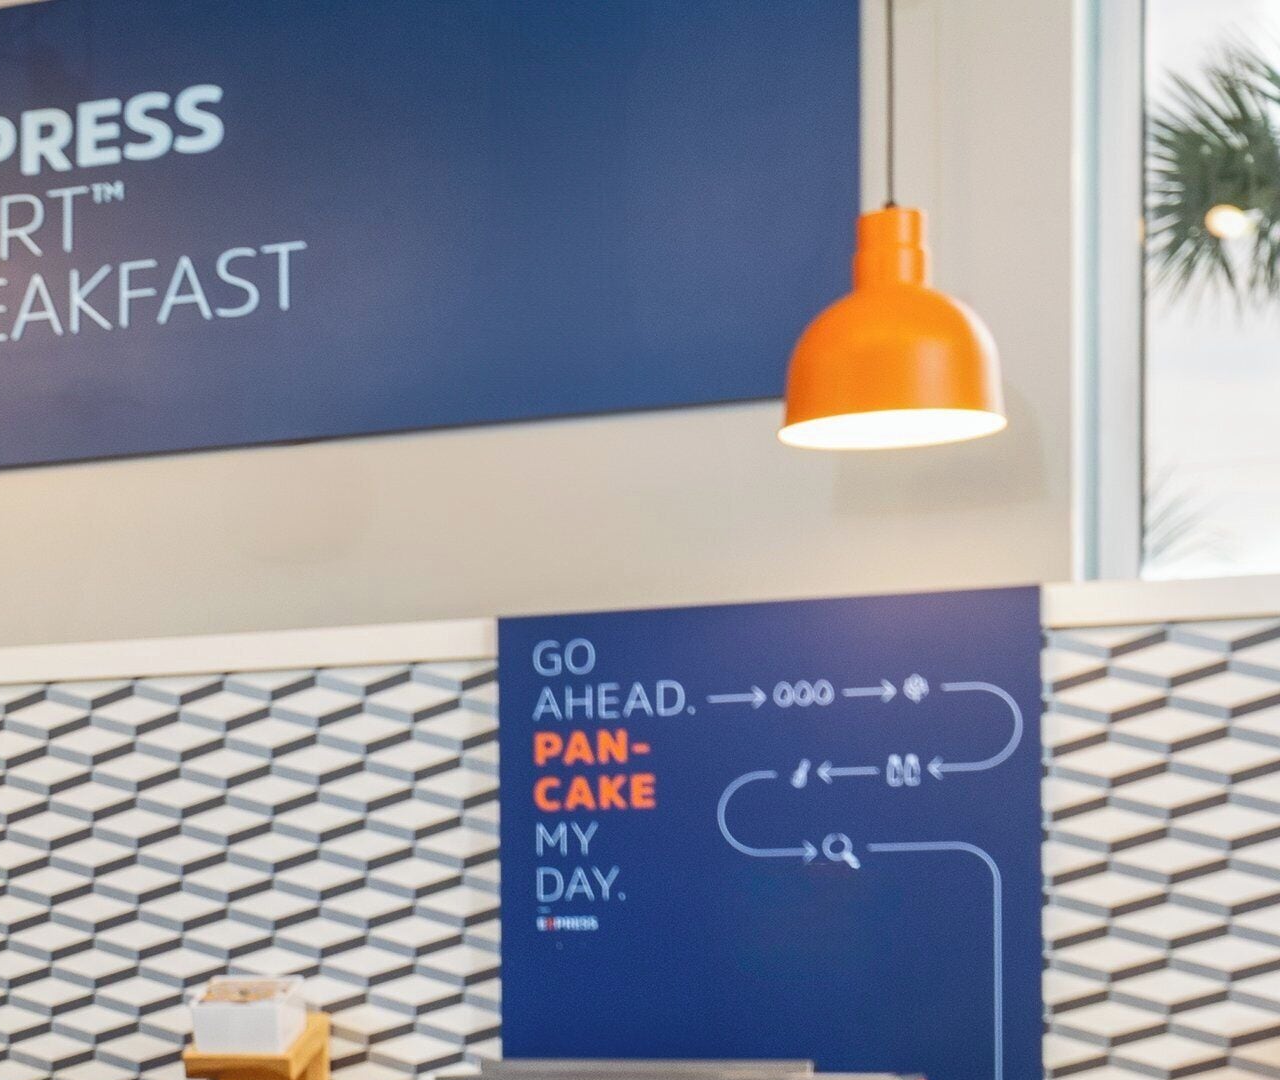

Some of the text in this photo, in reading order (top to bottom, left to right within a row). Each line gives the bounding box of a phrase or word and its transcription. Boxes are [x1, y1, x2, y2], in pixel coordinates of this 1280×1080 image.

[532, 637, 596, 677] GO
[532, 679, 696, 721] AHEAD.
[533, 727, 650, 766] PAN-
[533, 772, 657, 812] CAKE
[536, 821, 598, 857] MY
[536, 864, 626, 903] DAY.
